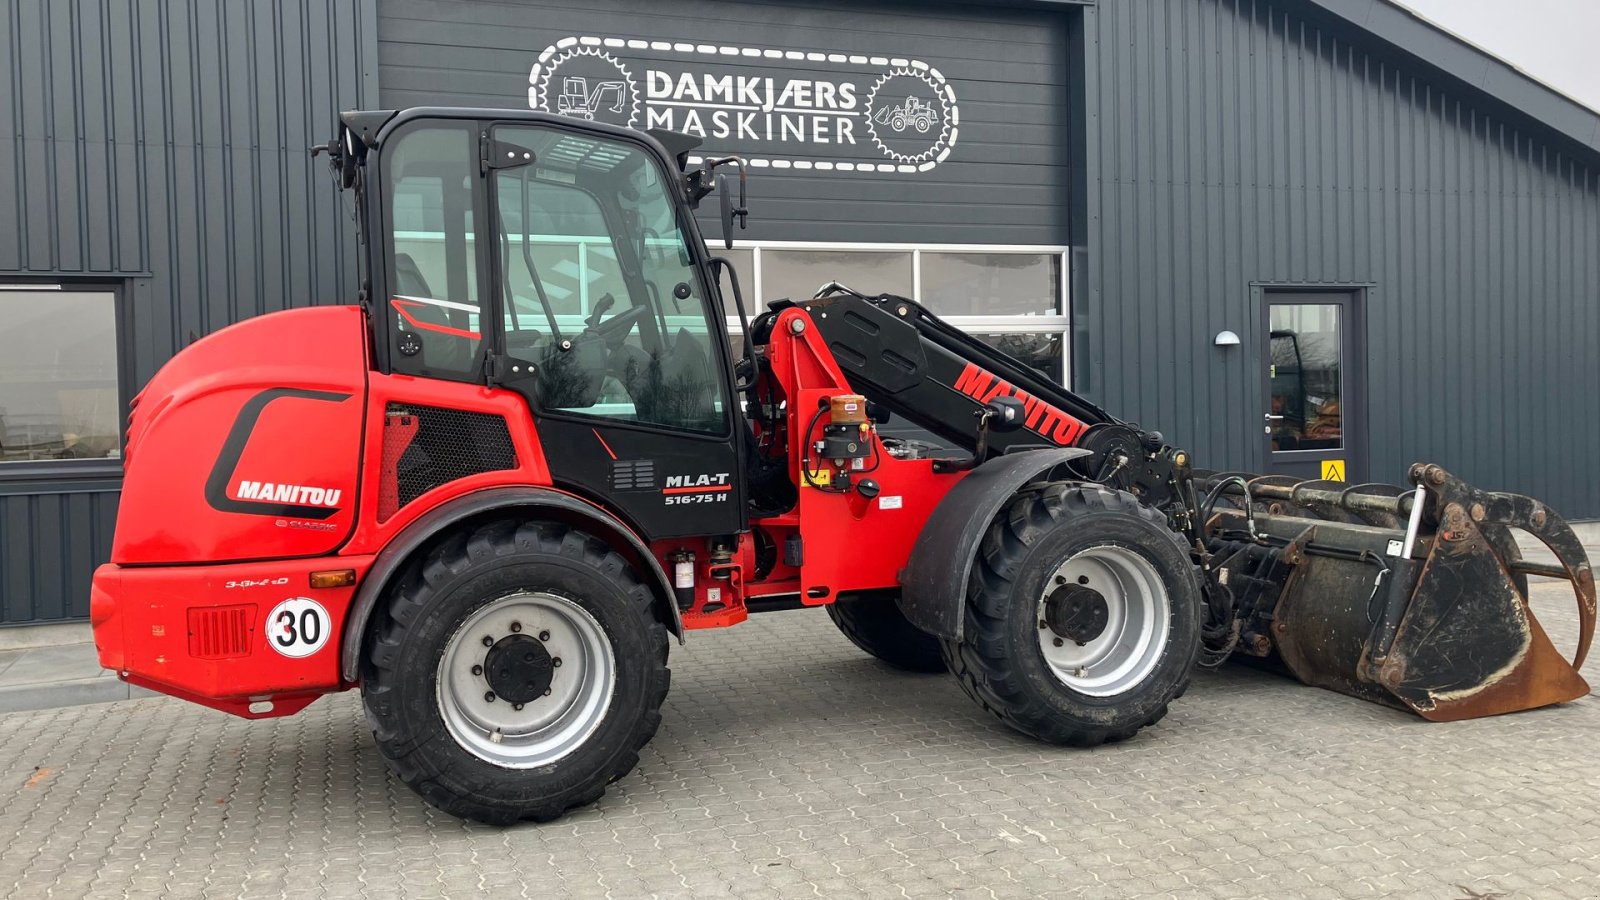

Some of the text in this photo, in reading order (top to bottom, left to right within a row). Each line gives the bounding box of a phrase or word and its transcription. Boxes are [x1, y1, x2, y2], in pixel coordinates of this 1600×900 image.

[646, 69, 857, 112] DAMKJÆRS
[646, 106, 857, 145] MASKINER
[237, 480, 342, 507] MANITOU
[665, 472, 730, 488] MLA-T
[664, 493, 728, 505] 516-75 H
[289, 520, 337, 532] CLASSIC
[275, 607, 321, 648] 30
